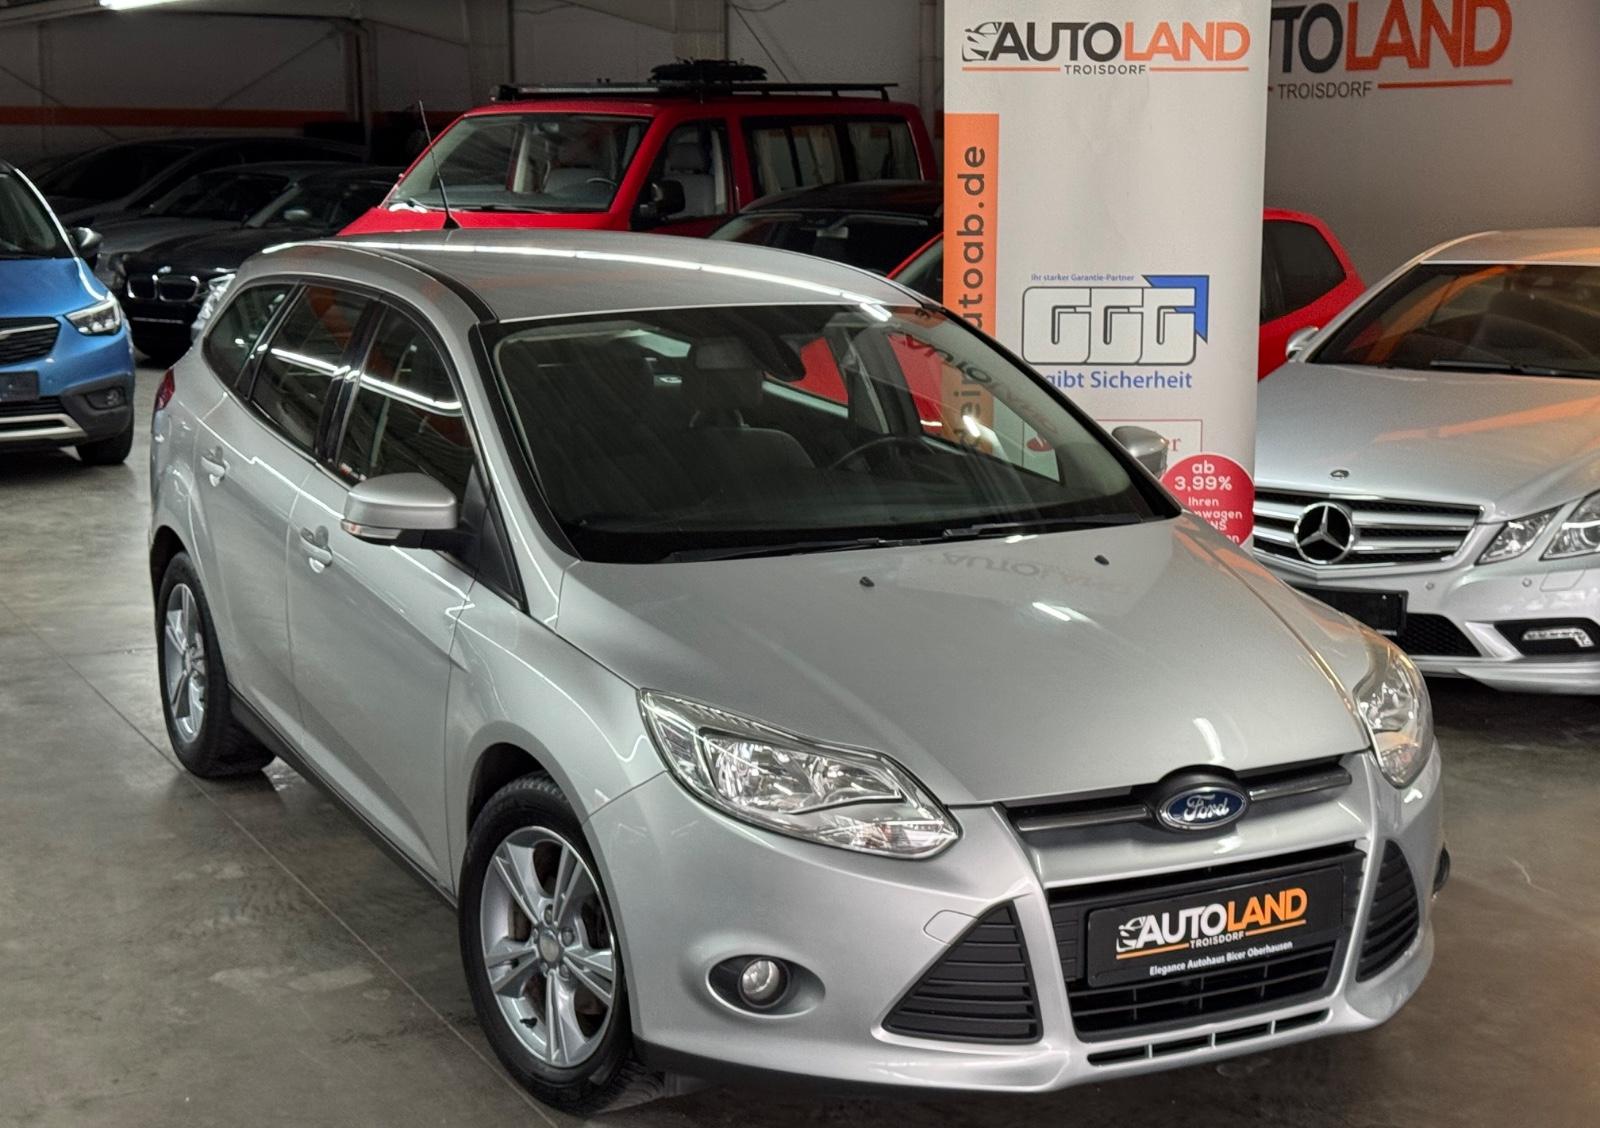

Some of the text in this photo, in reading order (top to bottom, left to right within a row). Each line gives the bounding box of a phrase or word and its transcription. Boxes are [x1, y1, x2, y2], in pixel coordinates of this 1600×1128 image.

[988, 21, 1251, 62] AUTOLAND
[1270, 0, 1513, 74] TOLAND
[1064, 64, 1146, 75] TROISDORF
[1277, 81, 1373, 100] TROISDORF
[1031, 273, 1135, 282] Ihr starker Garantie-Partner
[1090, 371, 1193, 388] Sicherheit
[1192, 460, 1215, 474] ab
[1174, 476, 1233, 492] 3,99%
[1188, 497, 1219, 507] Ihren
[1183, 794, 1230, 822] Ford
[1135, 887, 1308, 949] AUTOLAND
[1189, 930, 1245, 949] TROISDORF
[1149, 962, 1186, 976] Elegance
[1187, 955, 1225, 969] Autohaus
[1247, 941, 1293, 957] Oberhausen
